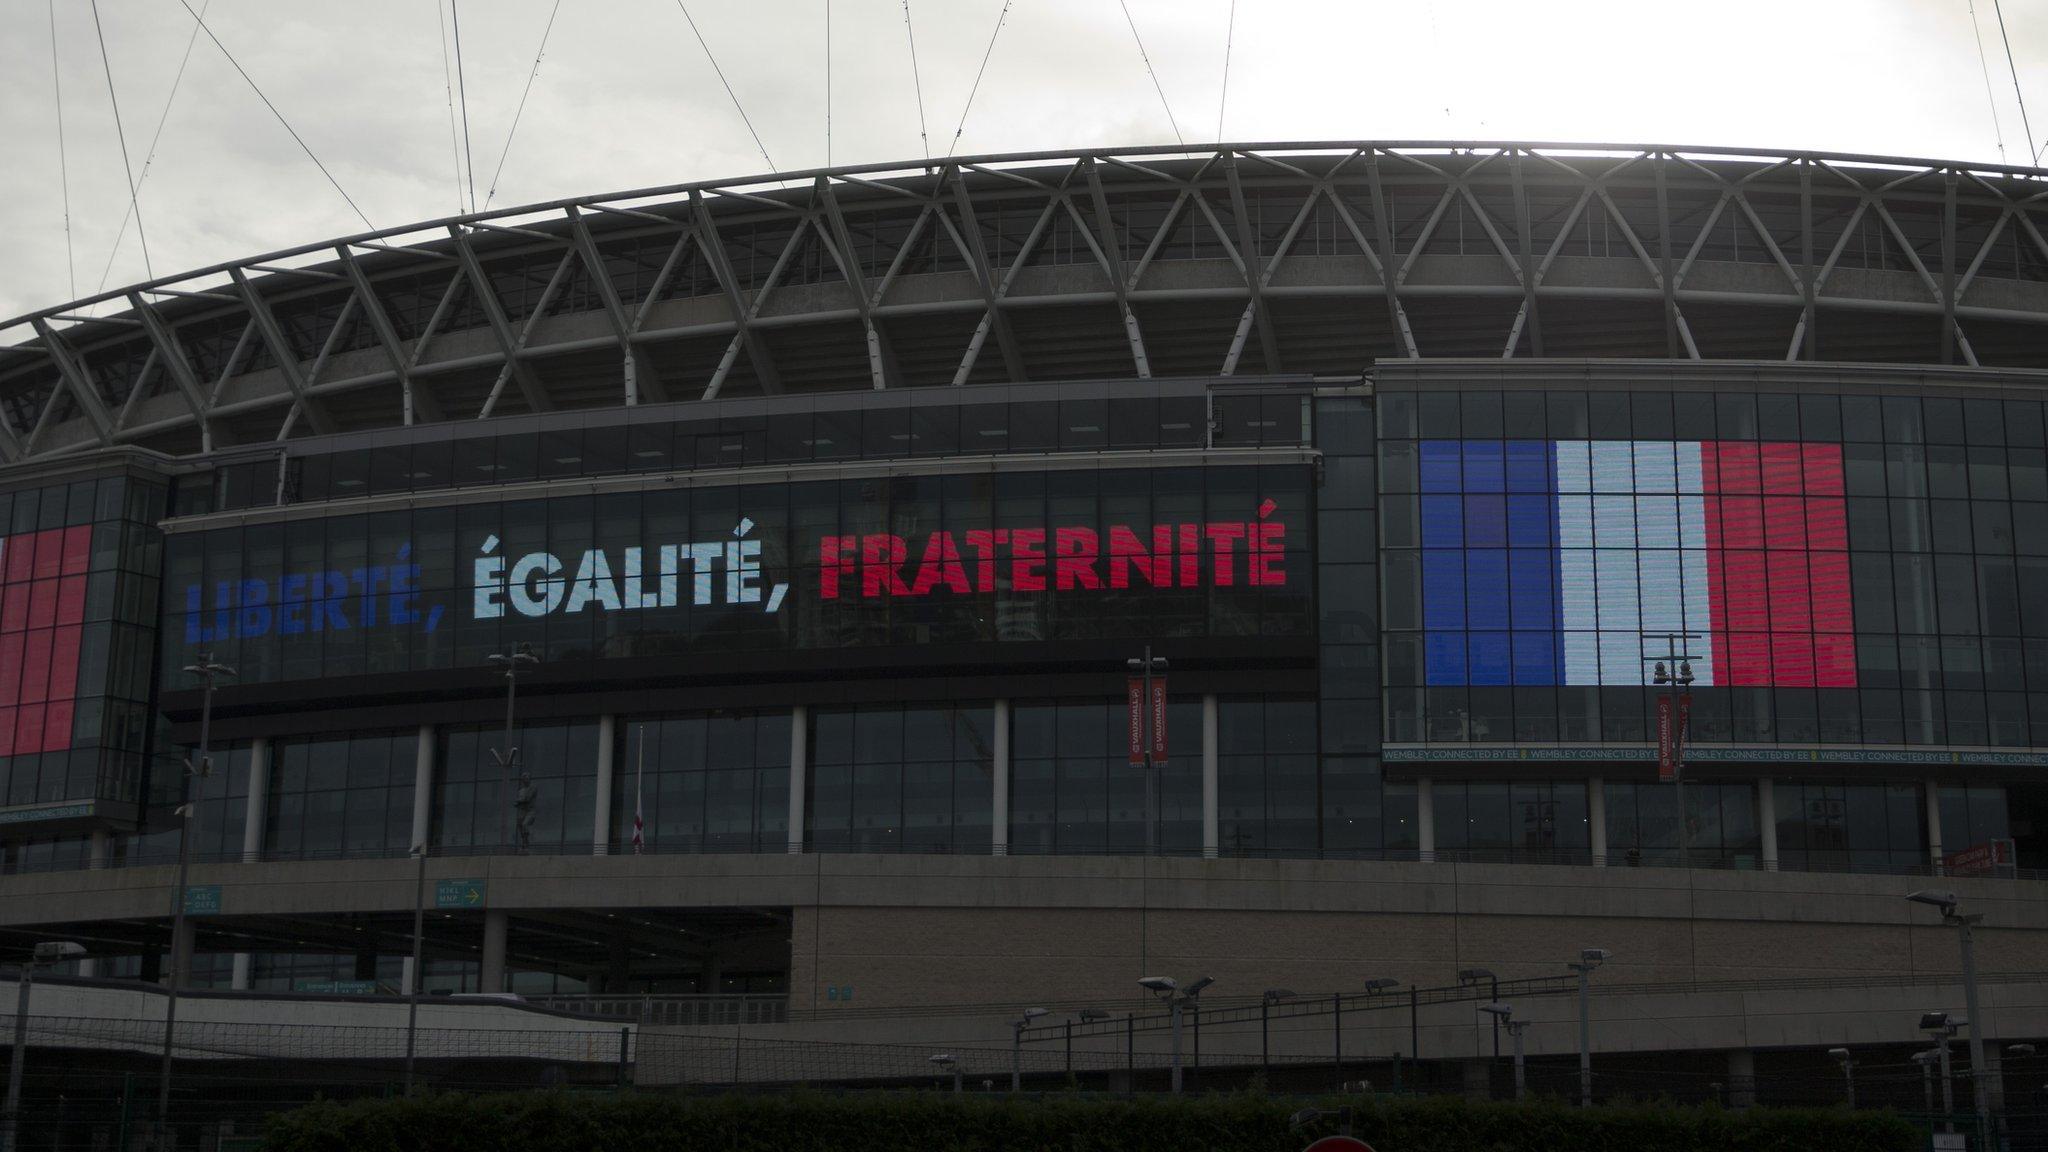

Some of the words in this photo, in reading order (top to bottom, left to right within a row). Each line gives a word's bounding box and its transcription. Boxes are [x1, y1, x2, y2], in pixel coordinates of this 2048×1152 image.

[184, 543, 445, 643] LIBERTÉ,
[473, 516, 788, 619] ÉGALITÉ,
[820, 498, 1286, 599] FRATERNITÉ
[1383, 750, 1430, 759] WEMBLEY
[1432, 750, 1491, 759] CONNECTED
[1492, 750, 1505, 759] BY
[1507, 750, 1519, 759] EE
[1530, 749, 1577, 758] WEMBLEY
[1580, 749, 1639, 758] CONNECTED
[1640, 749, 1651, 758] BY
[1725, 751, 1783, 759] CONNECTED
[1784, 751, 1795, 759] BY
[1797, 751, 1809, 759] EE
[1820, 751, 1866, 760] WEMBLEY
[1867, 752, 1924, 761] CONNECTED
[1925, 752, 1937, 761] BY
[1939, 752, 1951, 761] EE
[1962, 753, 2006, 762] WEMBLEY
[1660, 714, 1668, 757] VAUXHALL
